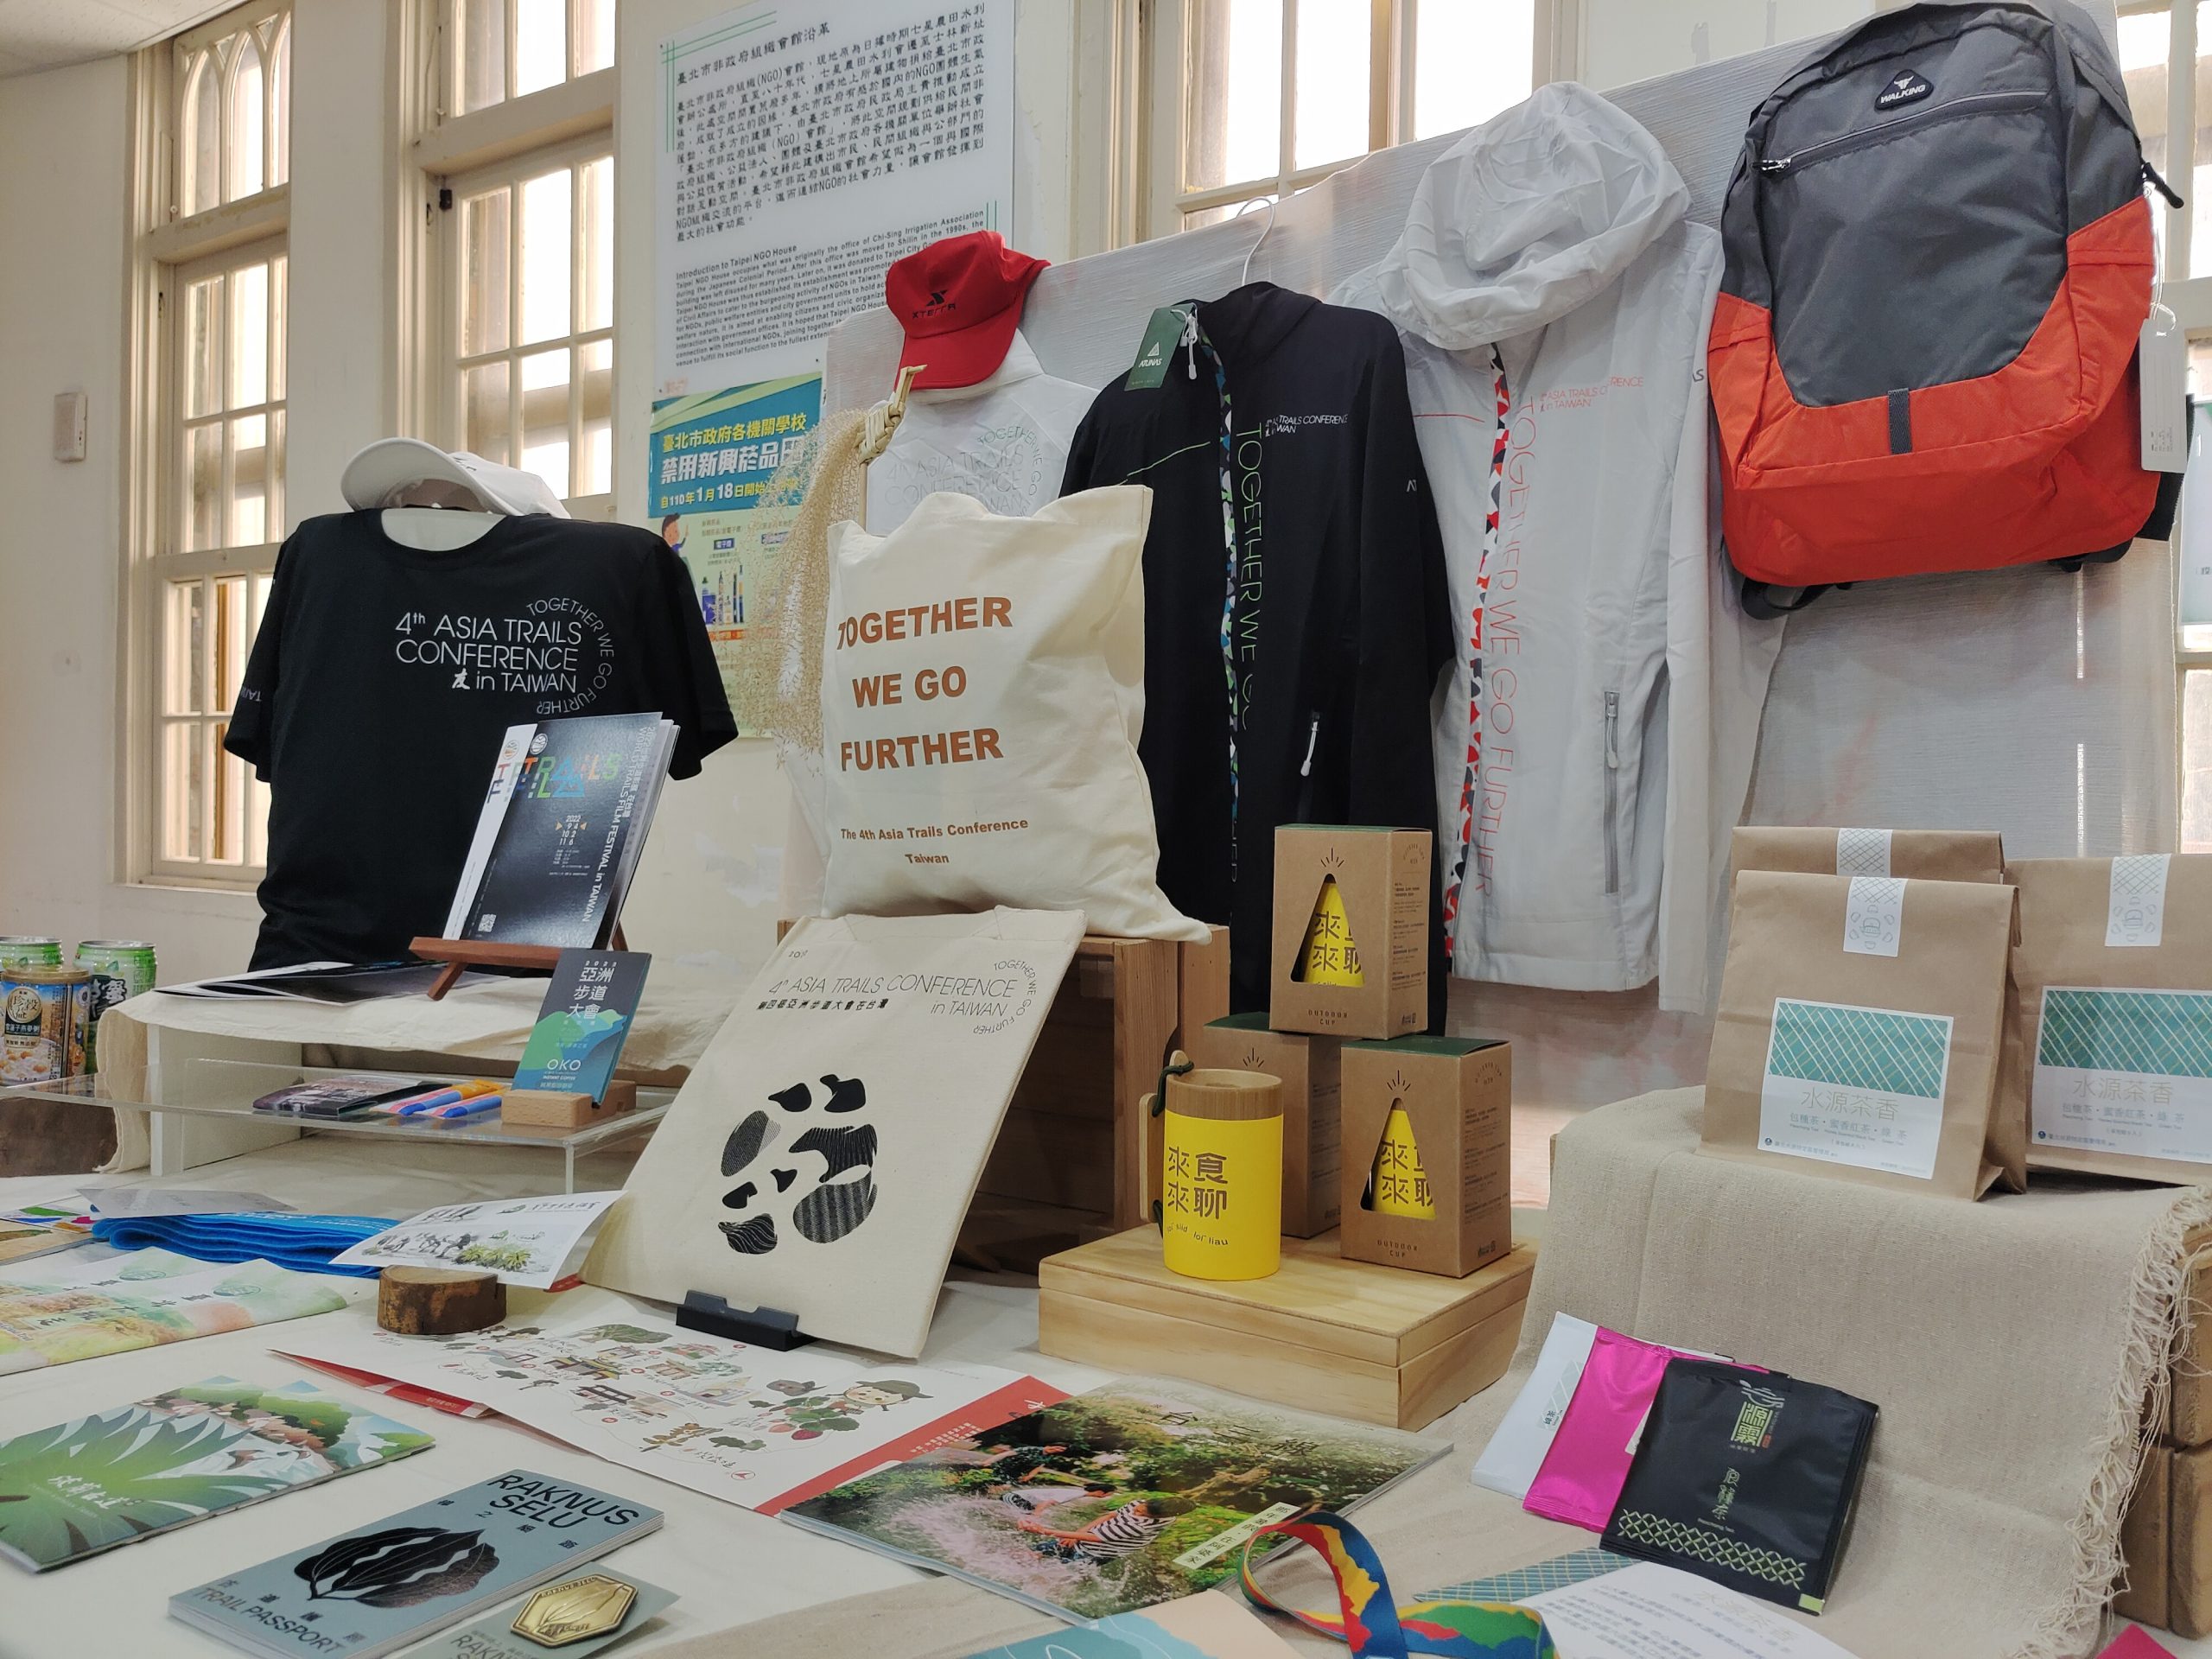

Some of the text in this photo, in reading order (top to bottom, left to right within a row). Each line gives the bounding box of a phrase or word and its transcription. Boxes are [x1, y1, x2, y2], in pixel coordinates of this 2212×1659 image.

[677, 22, 830, 85] 臺北市非政府組織會館沿革
[1880, 85, 1926, 104] WALKING
[795, 249, 824, 261] originally
[842, 241, 859, 250] office
[873, 231, 902, 243] Chi-Sing
[906, 223, 938, 235] Irrigation
[941, 212, 983, 226] Association
[825, 254, 842, 263] office
[862, 243, 884, 254] moved
[898, 236, 918, 245] Shilin
[676, 264, 720, 280] Introduction
[730, 254, 753, 267] Taipei
[754, 250, 771, 261] NGO
[772, 245, 798, 257] House
[848, 255, 874, 267] donated
[885, 247, 905, 258] Taipei
[803, 271, 848, 287] establishment
[663, 412, 807, 453] 臺北市政府各機關學校
[1279, 415, 1302, 424] TRAILS
[1236, 422, 1264, 602] TOGETHER
[395, 612, 582, 645] 4th ASIA TRAILS
[836, 596, 1013, 651] TOGETHER
[1240, 609, 1261, 662] WE
[1490, 606, 1521, 656] WE
[396, 639, 579, 671] CONFERENCE
[525, 597, 614, 715] TOGETHER WE GO FURTHER
[476, 671, 576, 693] in TAIWAN
[852, 665, 967, 709] WE GO
[1490, 665, 1517, 735] GO
[841, 728, 1004, 772] FURTHER
[613, 800, 628, 823] FILM
[1474, 748, 1515, 900] FURTHER
[841, 818, 1029, 841] The 4th Asia Trails Conference
[597, 824, 619, 870] FESTIVAL
[905, 853, 950, 864] Taiwan
[582, 883, 602, 922] TAIWAN
[579, 967, 615, 982] 亞洲
[790, 976, 827, 994] ASIA
[832, 977, 884, 994] TRAILS
[887, 974, 1018, 998] CONFERENCE
[573, 984, 608, 1001] 步道
[931, 1000, 1007, 1017] in TAIWAN
[973, 959, 1037, 1034] TOGETHER WE GO FURTHER
[566, 1003, 601, 1020] 大會
[1308, 1009, 1348, 1019] OUTDOOR
[547, 1058, 582, 1071] OKO
[1801, 1087, 1900, 1122] 水源茶香
[2073, 1075, 2173, 1105] 水源茶香
[1376, 1240, 1418, 1251] OUTDOOR
[487, 1474, 639, 1527] RAKNUS
[490, 1494, 589, 1529] SELU
[194, 1587, 346, 1656] TRAIL PASSPORT
